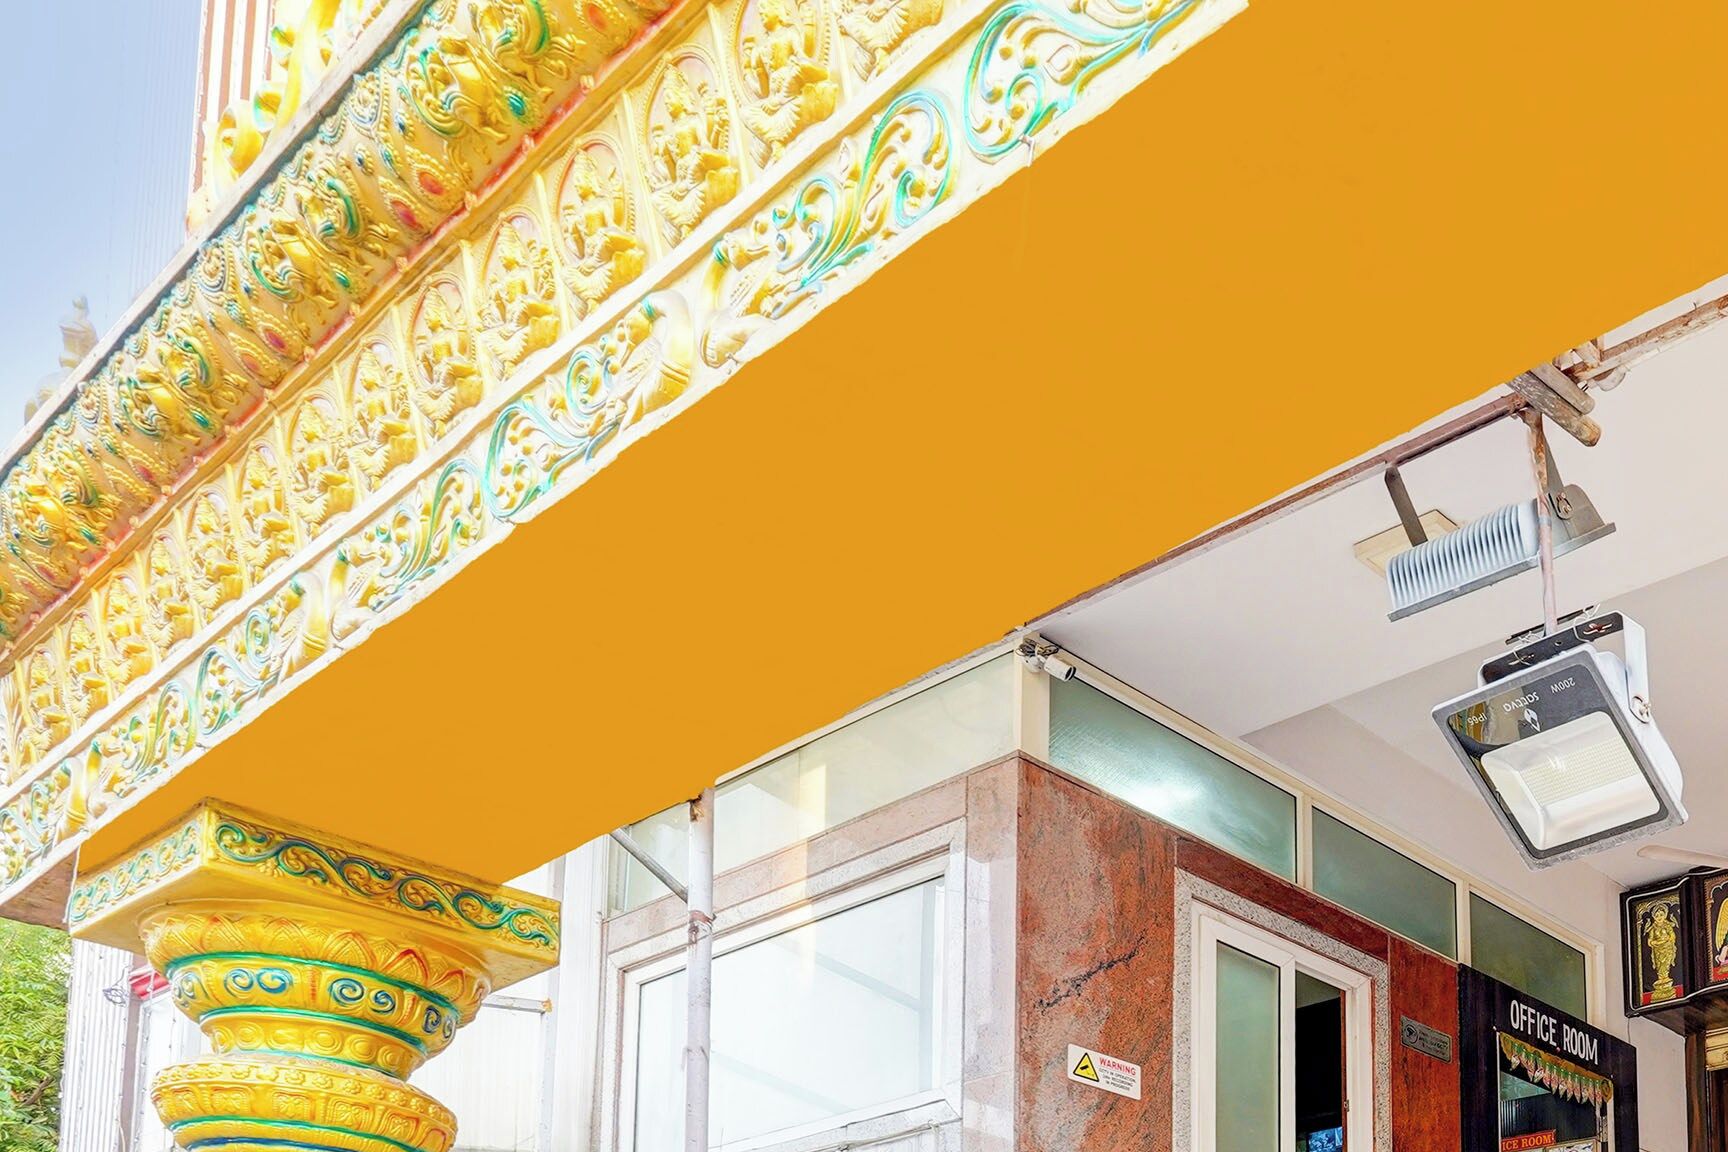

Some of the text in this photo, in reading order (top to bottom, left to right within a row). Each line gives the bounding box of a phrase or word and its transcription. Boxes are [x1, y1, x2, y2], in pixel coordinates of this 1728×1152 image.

[1467, 677, 1576, 726] 200W sattva IP65
[1510, 999, 1599, 1065] OFFICE ROOM
[1099, 1057, 1136, 1076] WARNING
[1521, 1134, 1552, 1148] ROOM
